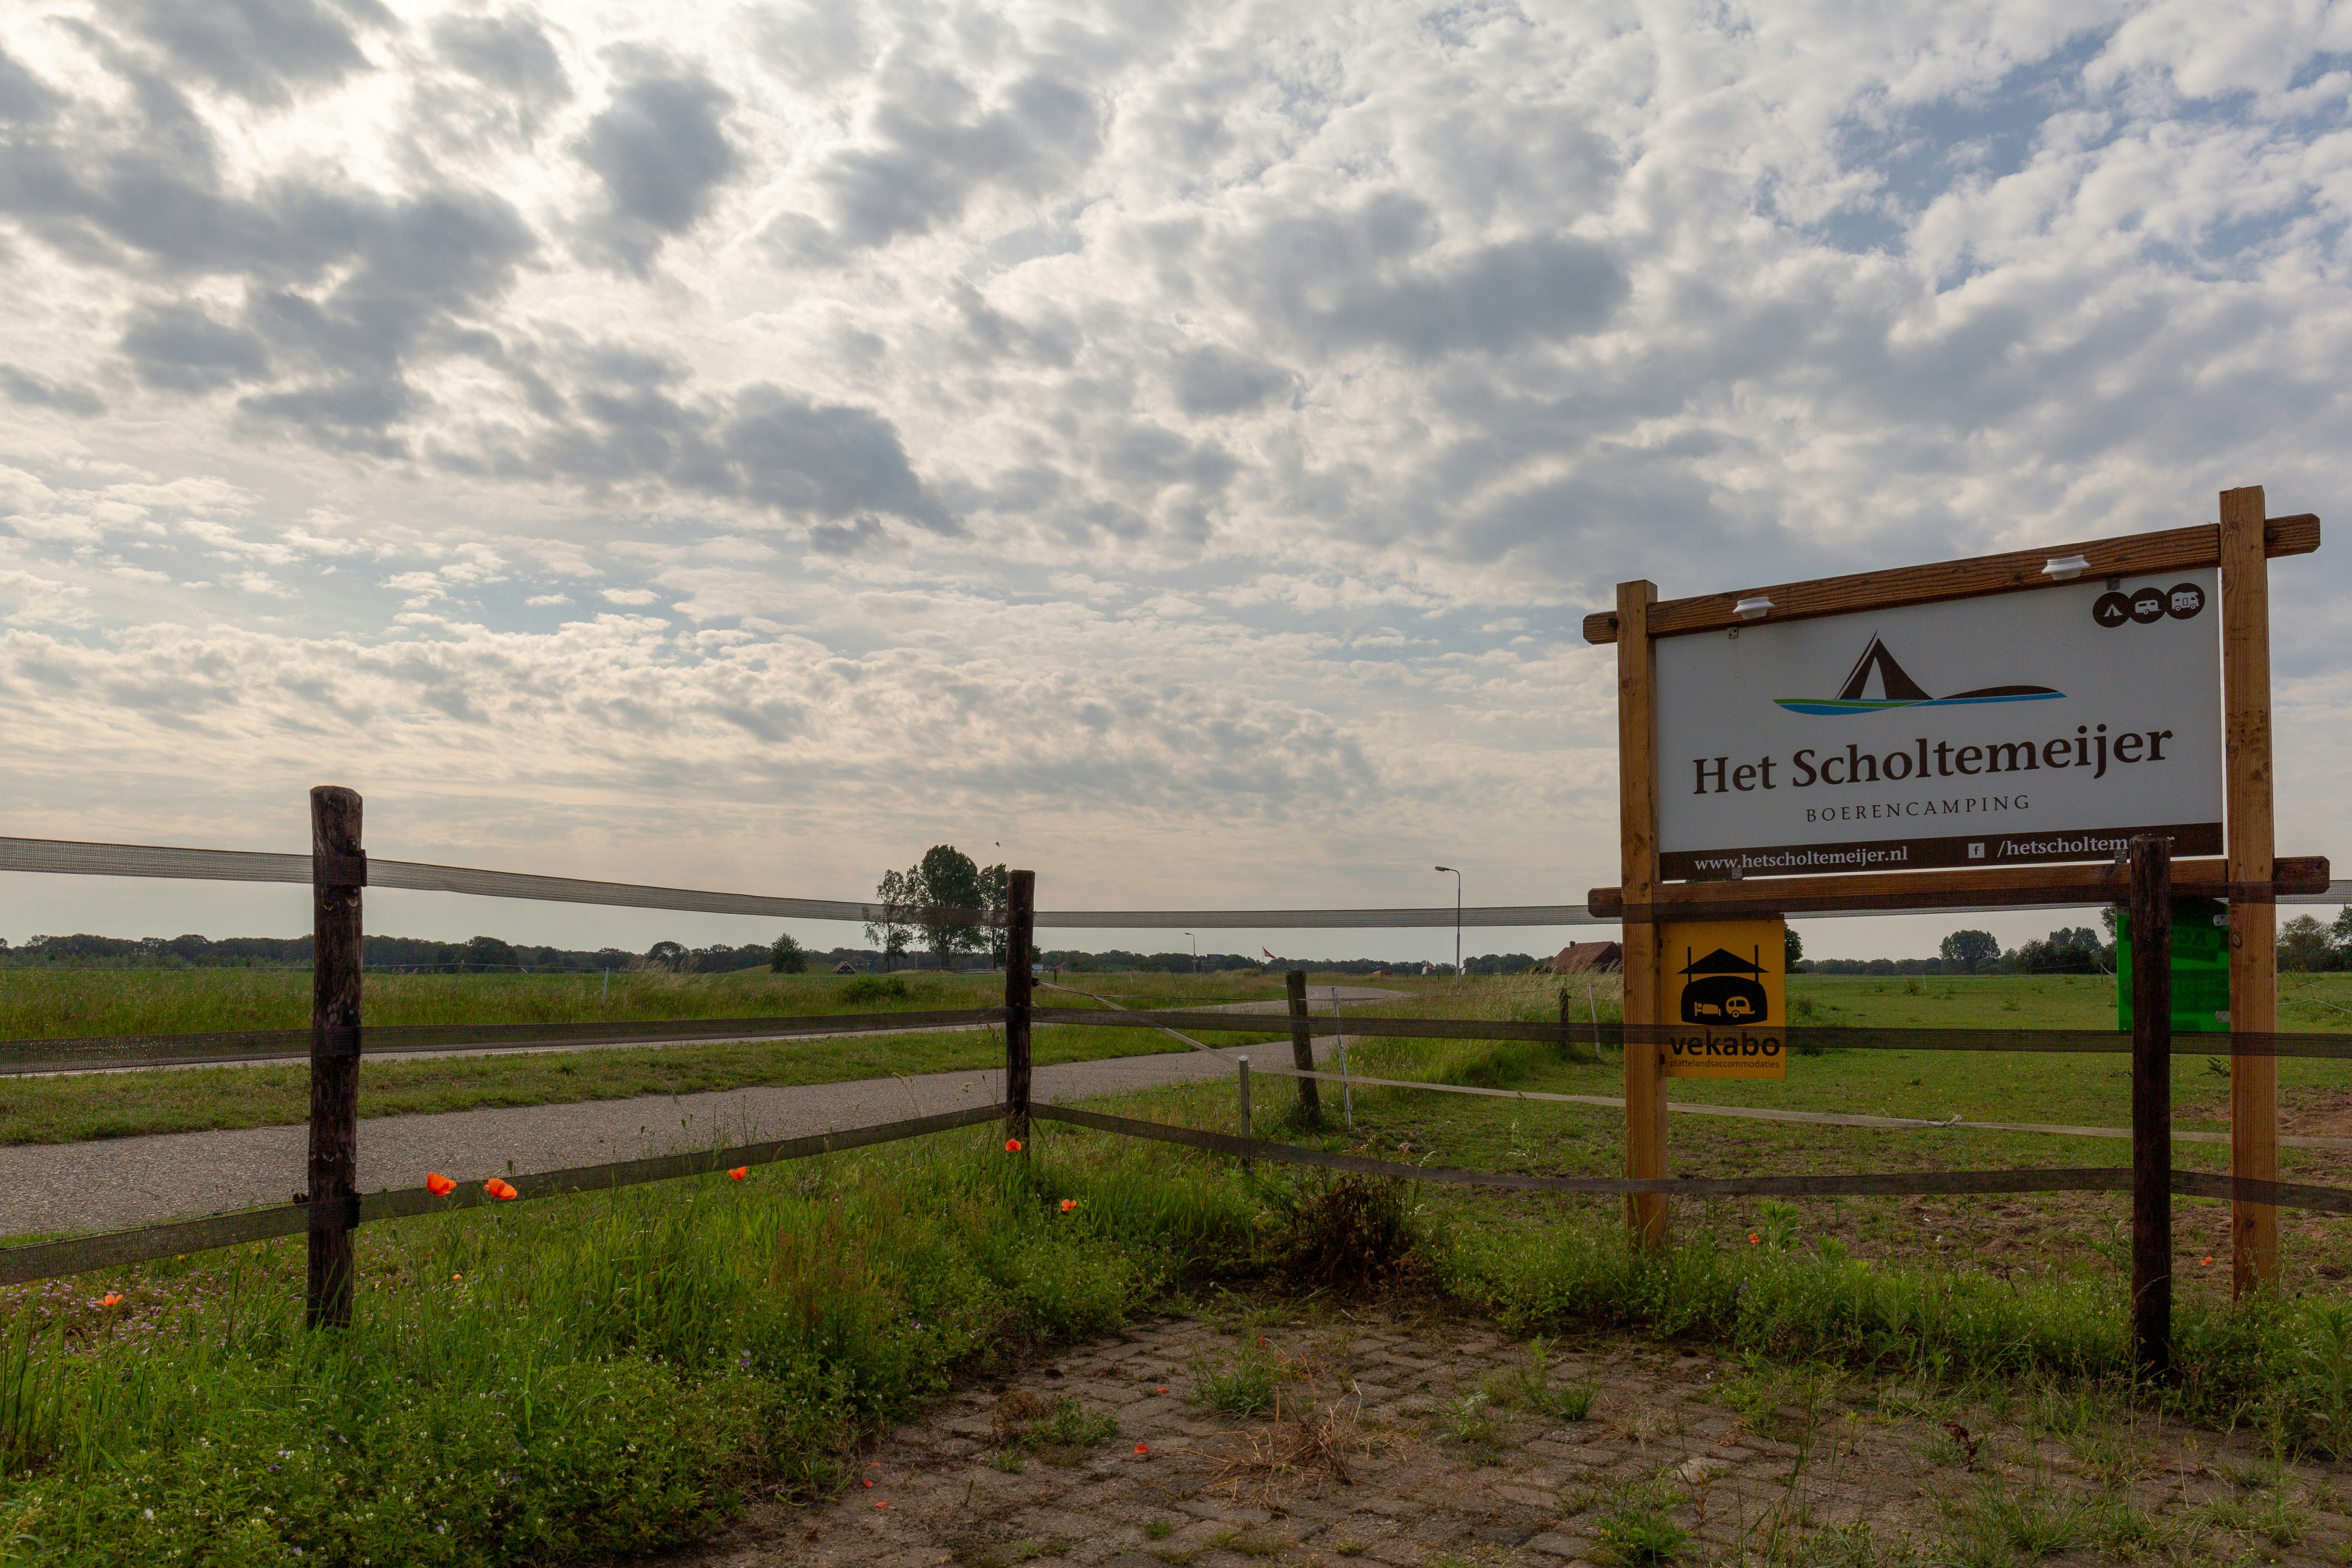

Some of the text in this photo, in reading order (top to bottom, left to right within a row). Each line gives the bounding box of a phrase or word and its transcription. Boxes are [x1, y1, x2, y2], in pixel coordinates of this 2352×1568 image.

[1693, 723, 2174, 795] Het Scholtemeijer
[1806, 795, 2029, 822] BOERENCAMPING
[1694, 846, 1908, 870] www.hetscholtemeijer.nl
[1669, 1029, 1780, 1057] vekabo
[1670, 1059, 1780, 1068] plattelandsaccommodaties
